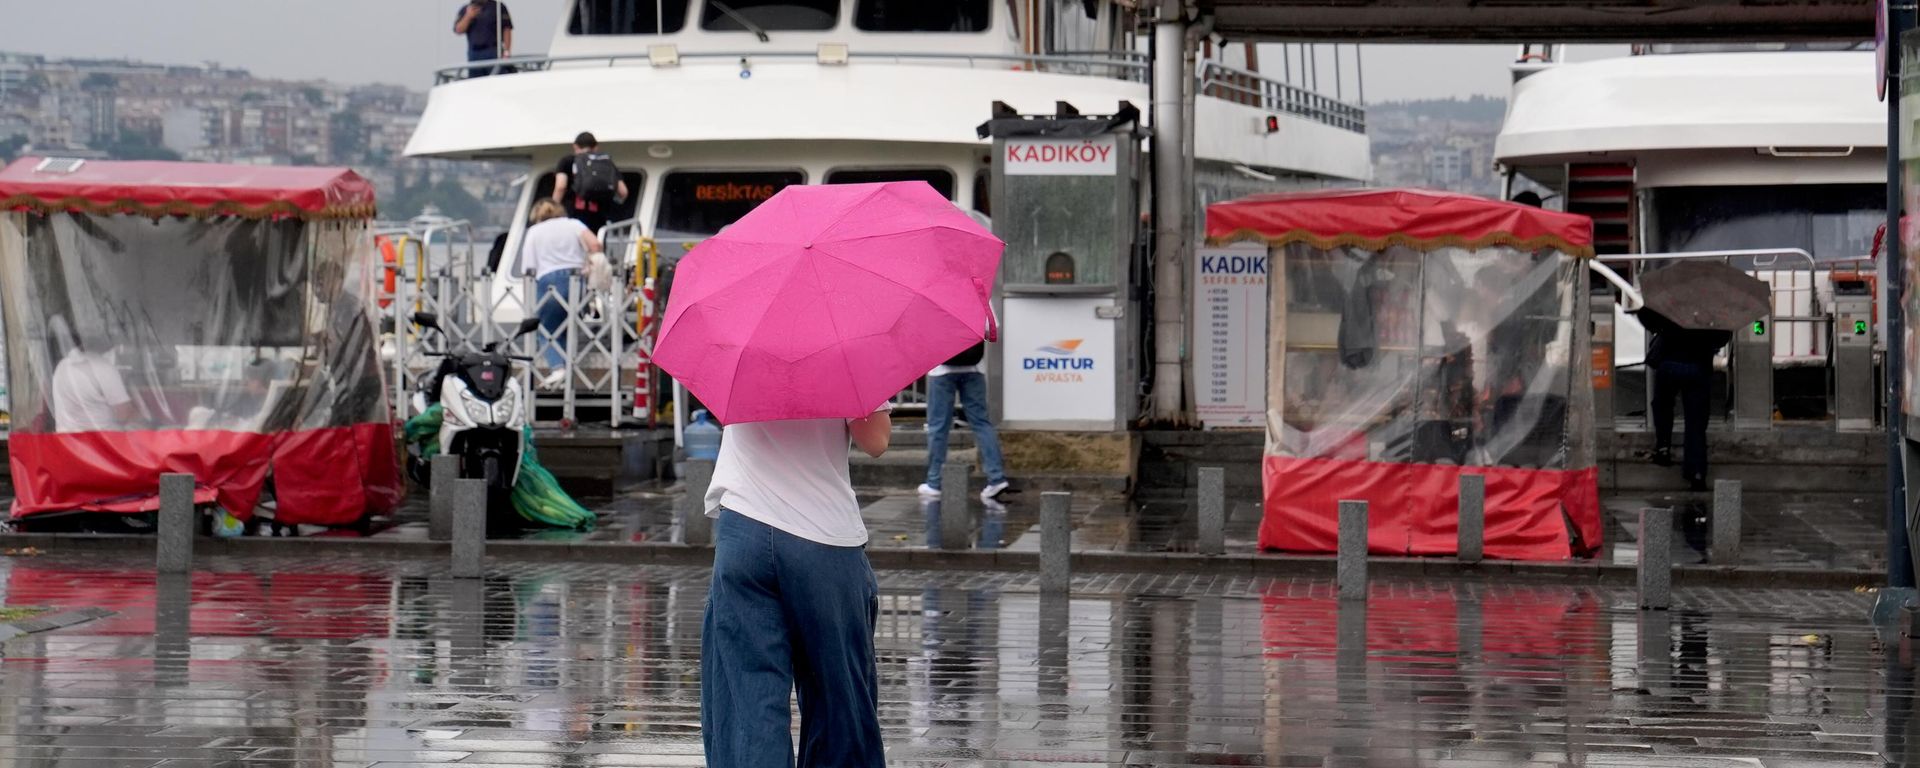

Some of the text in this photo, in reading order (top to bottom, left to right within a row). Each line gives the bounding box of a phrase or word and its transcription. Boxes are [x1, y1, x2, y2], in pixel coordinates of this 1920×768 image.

[1007, 140, 1112, 162] KADIKÖY
[1202, 256, 1266, 274] KADIK
[1203, 275, 1238, 285] SEFER
[1023, 358, 1094, 370] DENTUR
[1034, 373, 1084, 383] AVRASYA
